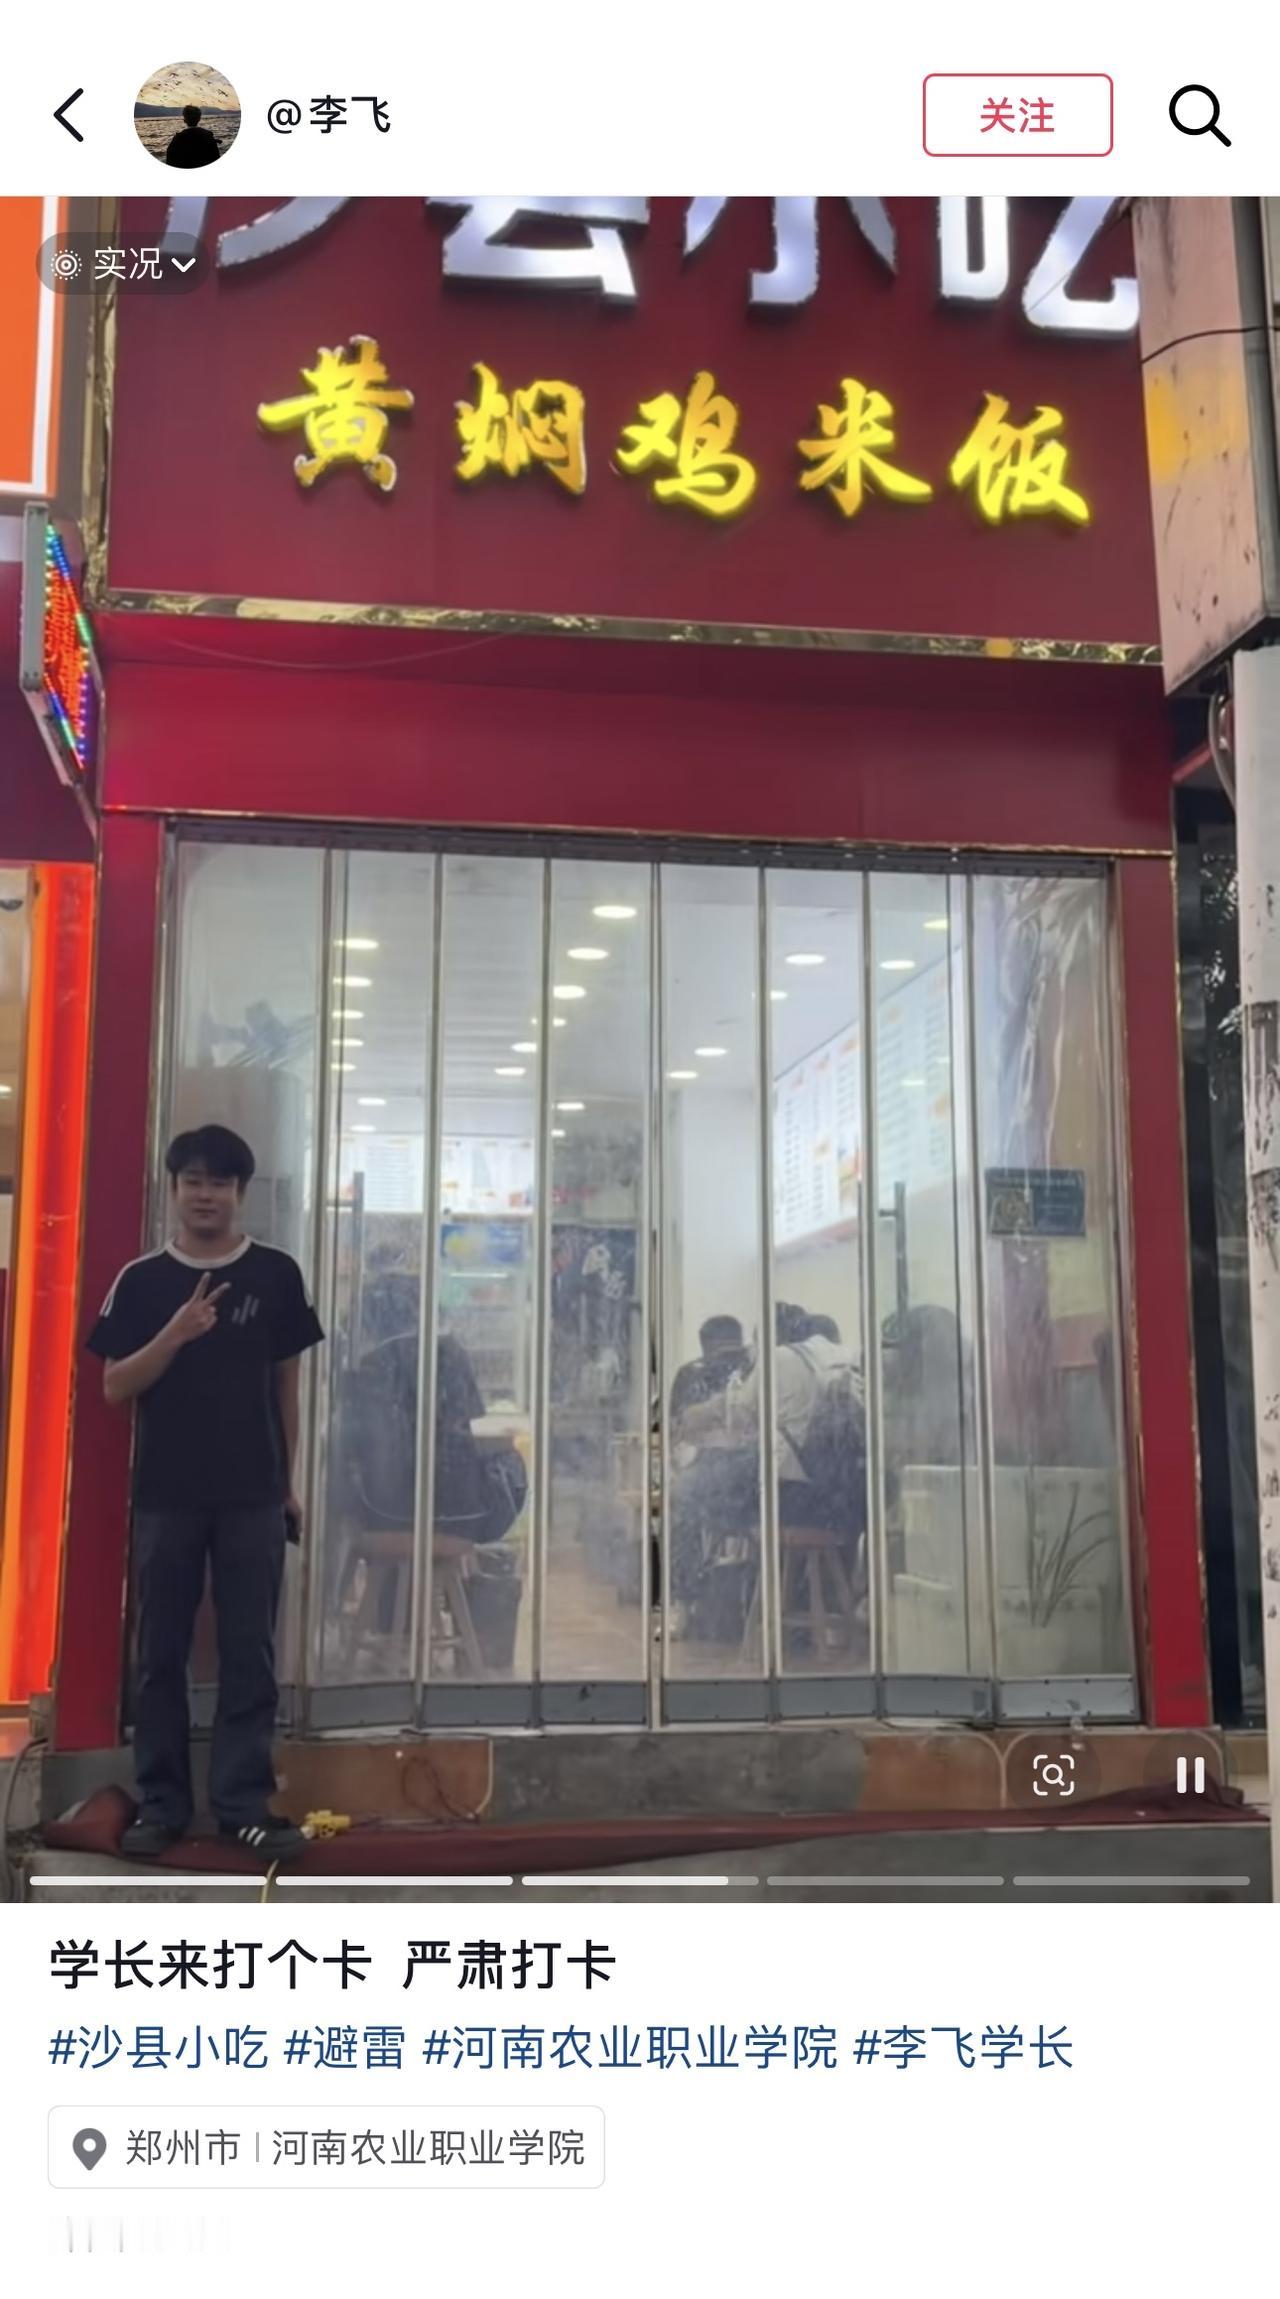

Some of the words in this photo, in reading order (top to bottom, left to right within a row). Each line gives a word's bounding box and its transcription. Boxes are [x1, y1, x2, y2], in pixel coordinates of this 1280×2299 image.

[257, 335, 1090, 525] 黄焖鸡米饭
